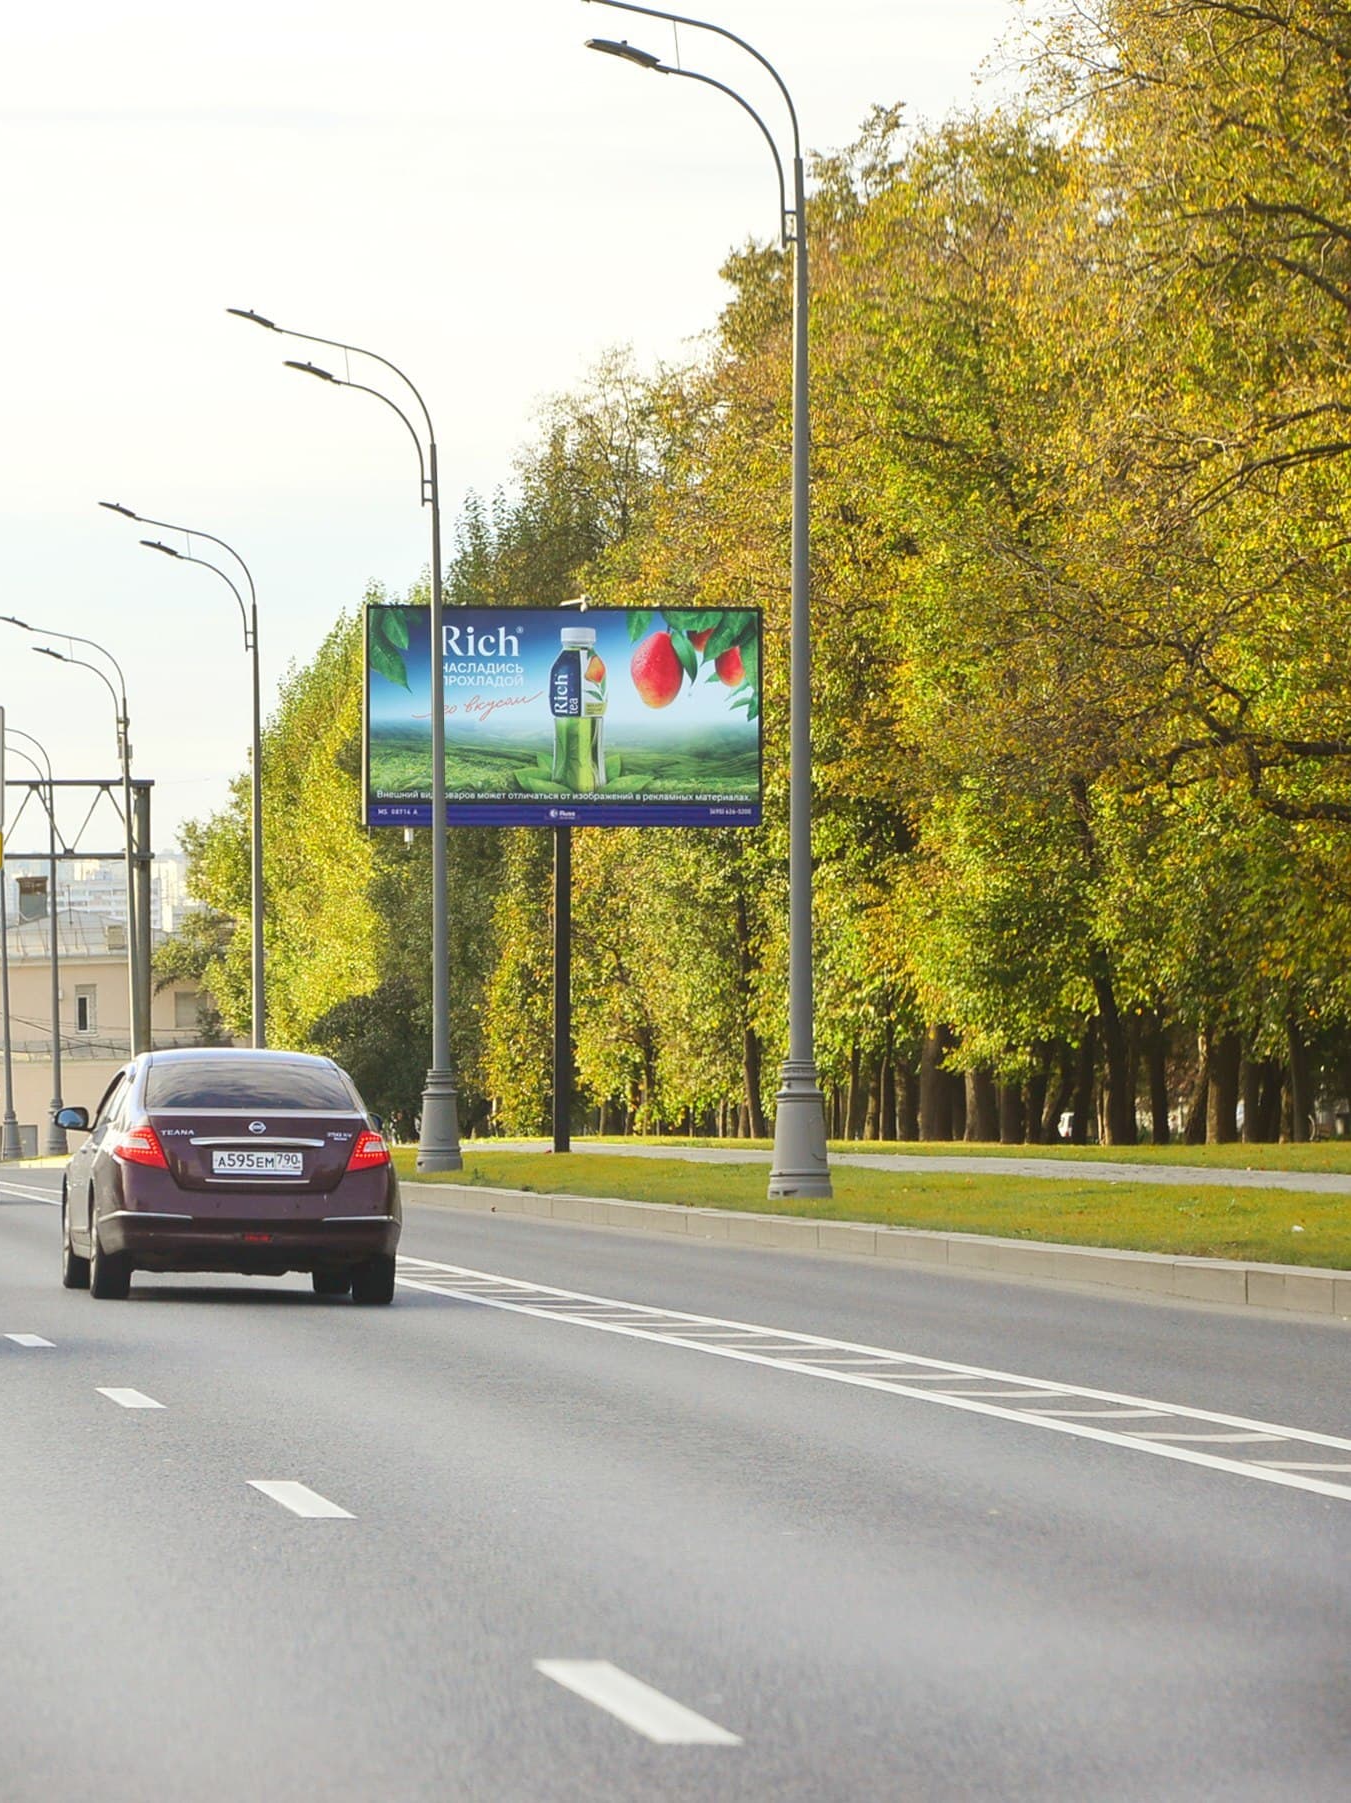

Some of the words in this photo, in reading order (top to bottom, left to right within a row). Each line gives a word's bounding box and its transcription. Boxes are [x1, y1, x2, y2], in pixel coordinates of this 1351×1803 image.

[441, 625, 520, 657] Rich
[553, 674, 568, 714] Rich
[569, 697, 579, 715] tea
[376, 789, 419, 799] Внешний
[444, 791, 475, 801] варов
[508, 792, 559, 800] отличаться
[572, 792, 634, 802] изображений
[642, 793, 694, 803] рекламных
